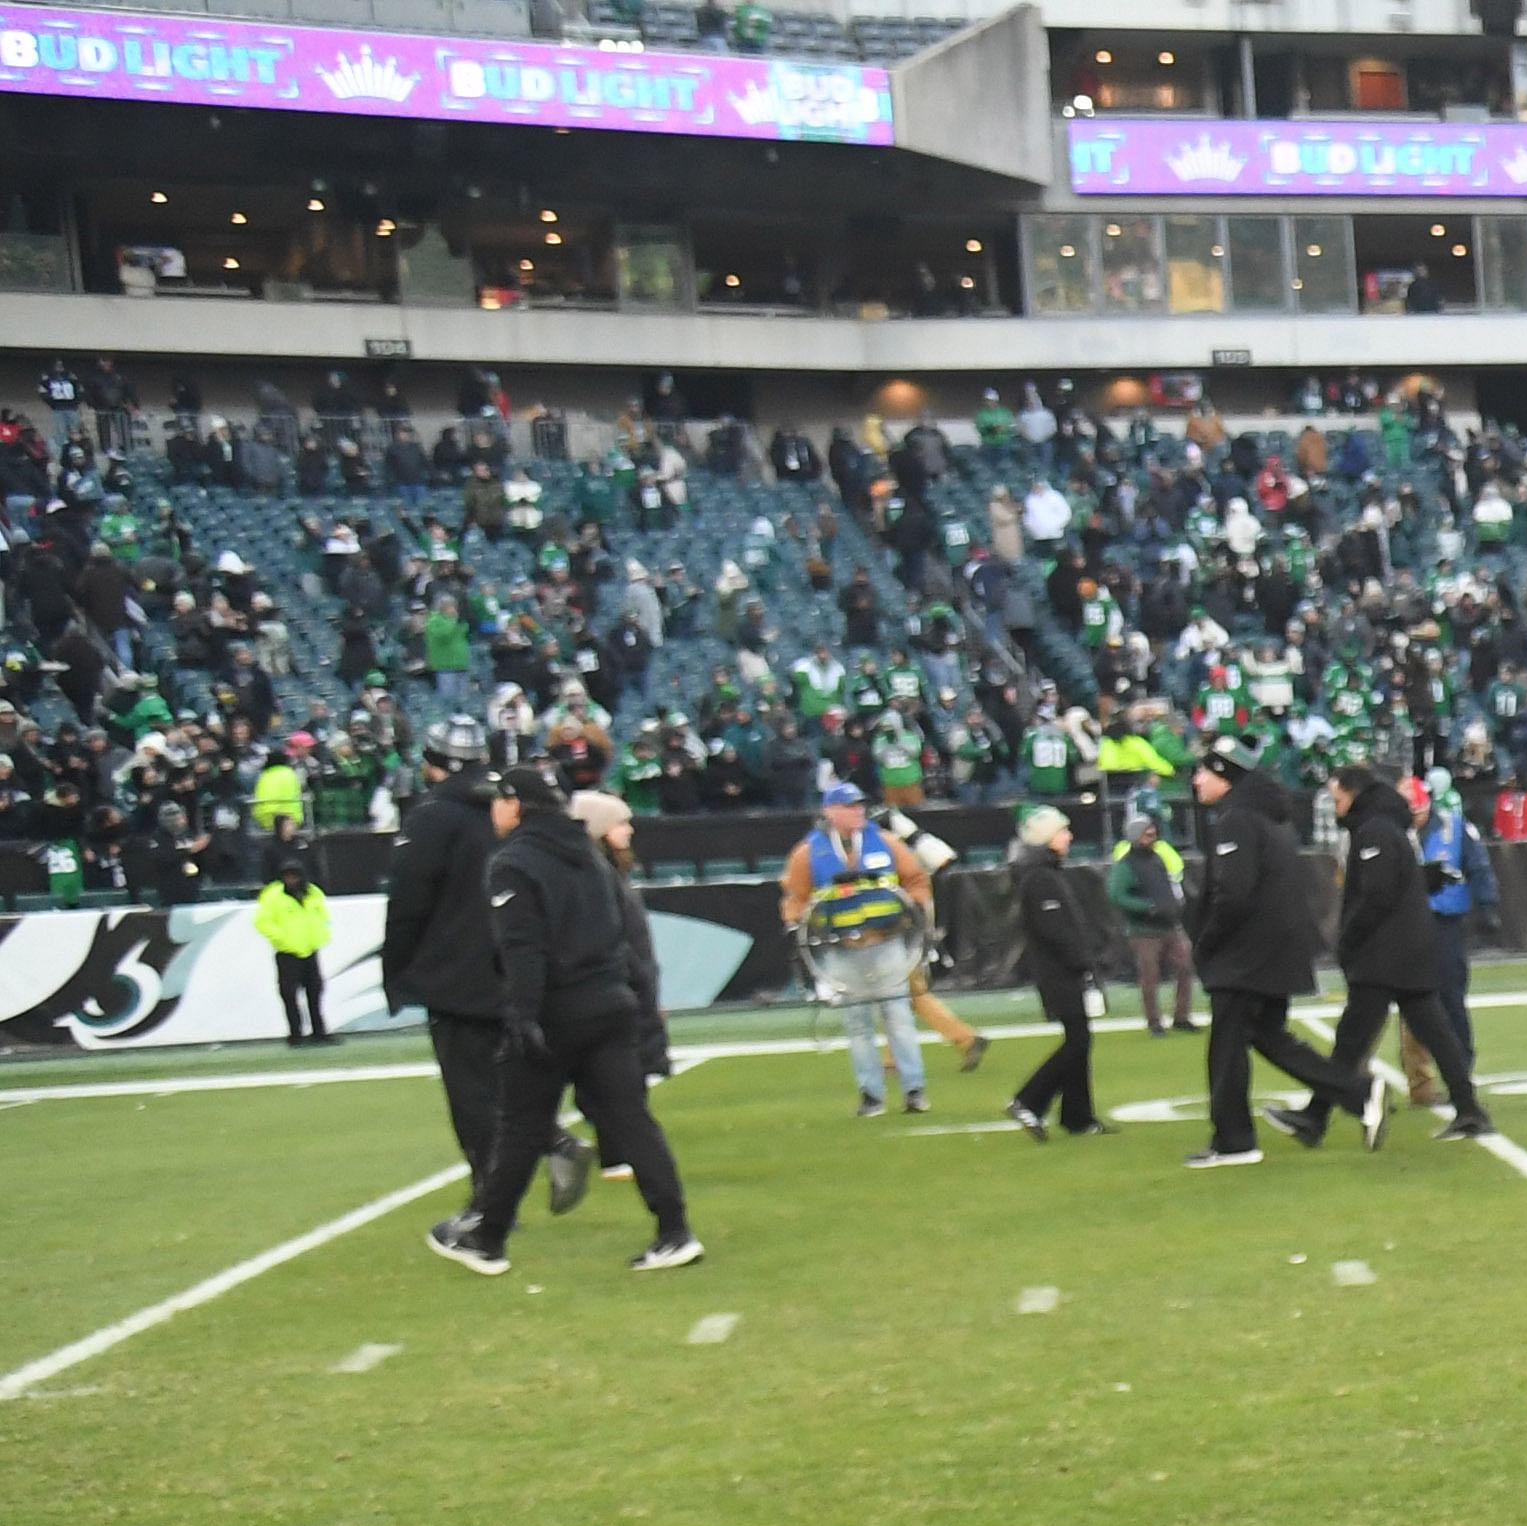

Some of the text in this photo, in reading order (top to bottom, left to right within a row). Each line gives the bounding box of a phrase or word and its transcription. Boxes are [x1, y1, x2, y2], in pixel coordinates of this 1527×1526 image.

[1, 30, 281, 84] BUD LIGHT
[451, 61, 698, 110] BUD LIGHT
[1271, 142, 1475, 175] BUD LIGHT
